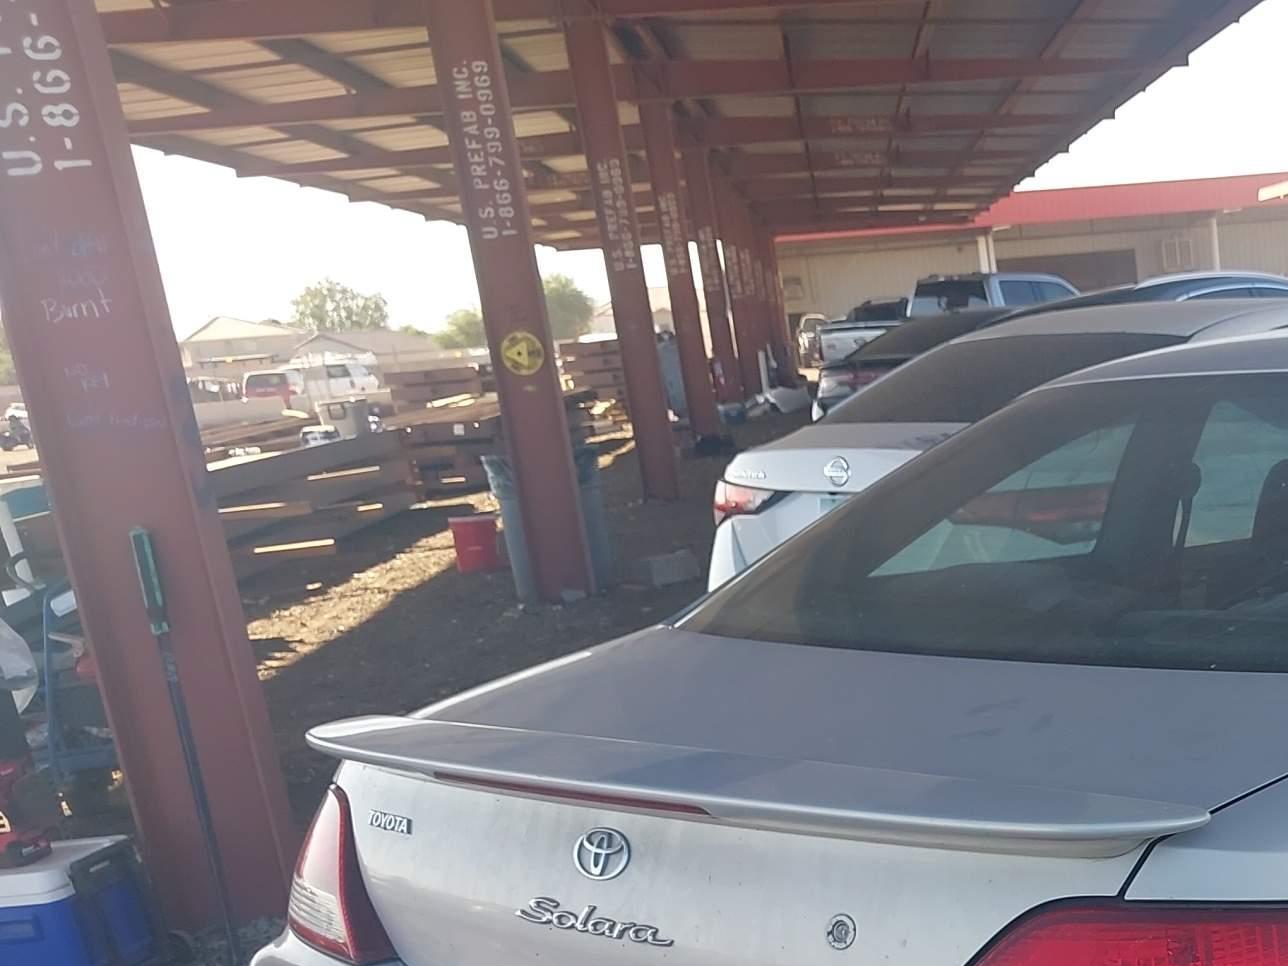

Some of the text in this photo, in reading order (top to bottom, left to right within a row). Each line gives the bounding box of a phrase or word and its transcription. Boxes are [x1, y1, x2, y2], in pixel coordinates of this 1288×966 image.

[452, 60, 499, 239] U.S. PREFAB INC.
[471, 60, 519, 236] 1-866-799-0969
[40, 287, 112, 323] Burnt
[367, 810, 408, 834] TOYOTA
[514, 896, 675, 947] Solara
